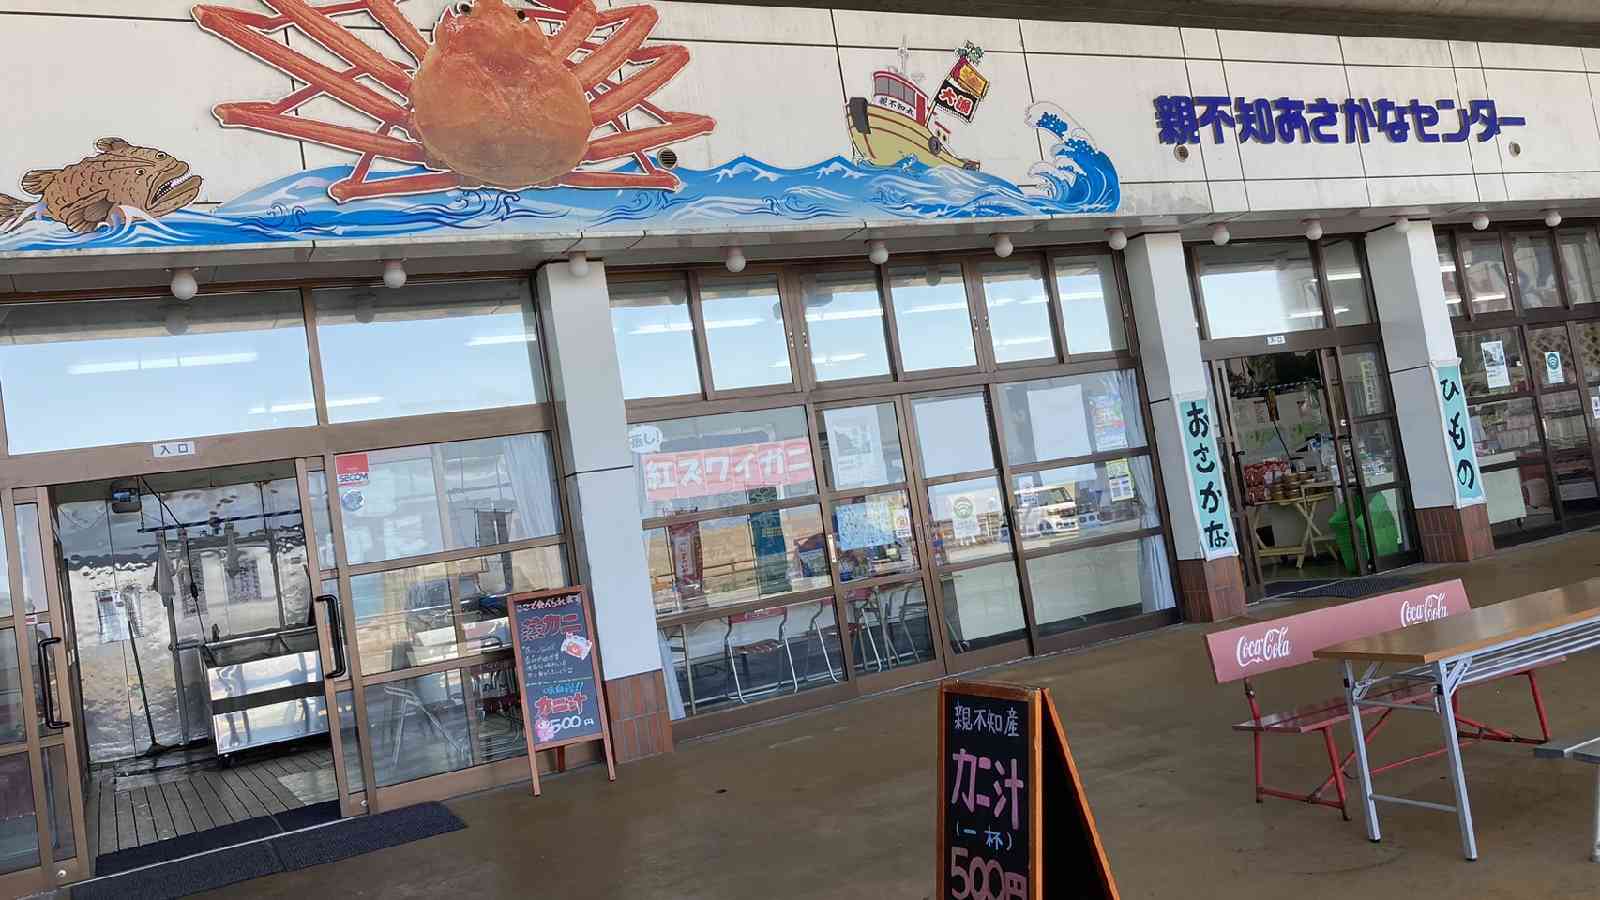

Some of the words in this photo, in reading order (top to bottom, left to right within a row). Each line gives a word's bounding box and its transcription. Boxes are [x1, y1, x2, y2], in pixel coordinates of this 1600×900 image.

[1152, 94, 1526, 145] 親不知あさかなセンター
[159, 443, 189, 455] 入口
[1439, 378, 1475, 490] ひもの
[1186, 401, 1230, 548] おさかな
[954, 704, 1020, 737] 親不知産
[951, 747, 1025, 831] カニ汁
[951, 846, 1028, 900] 500円
